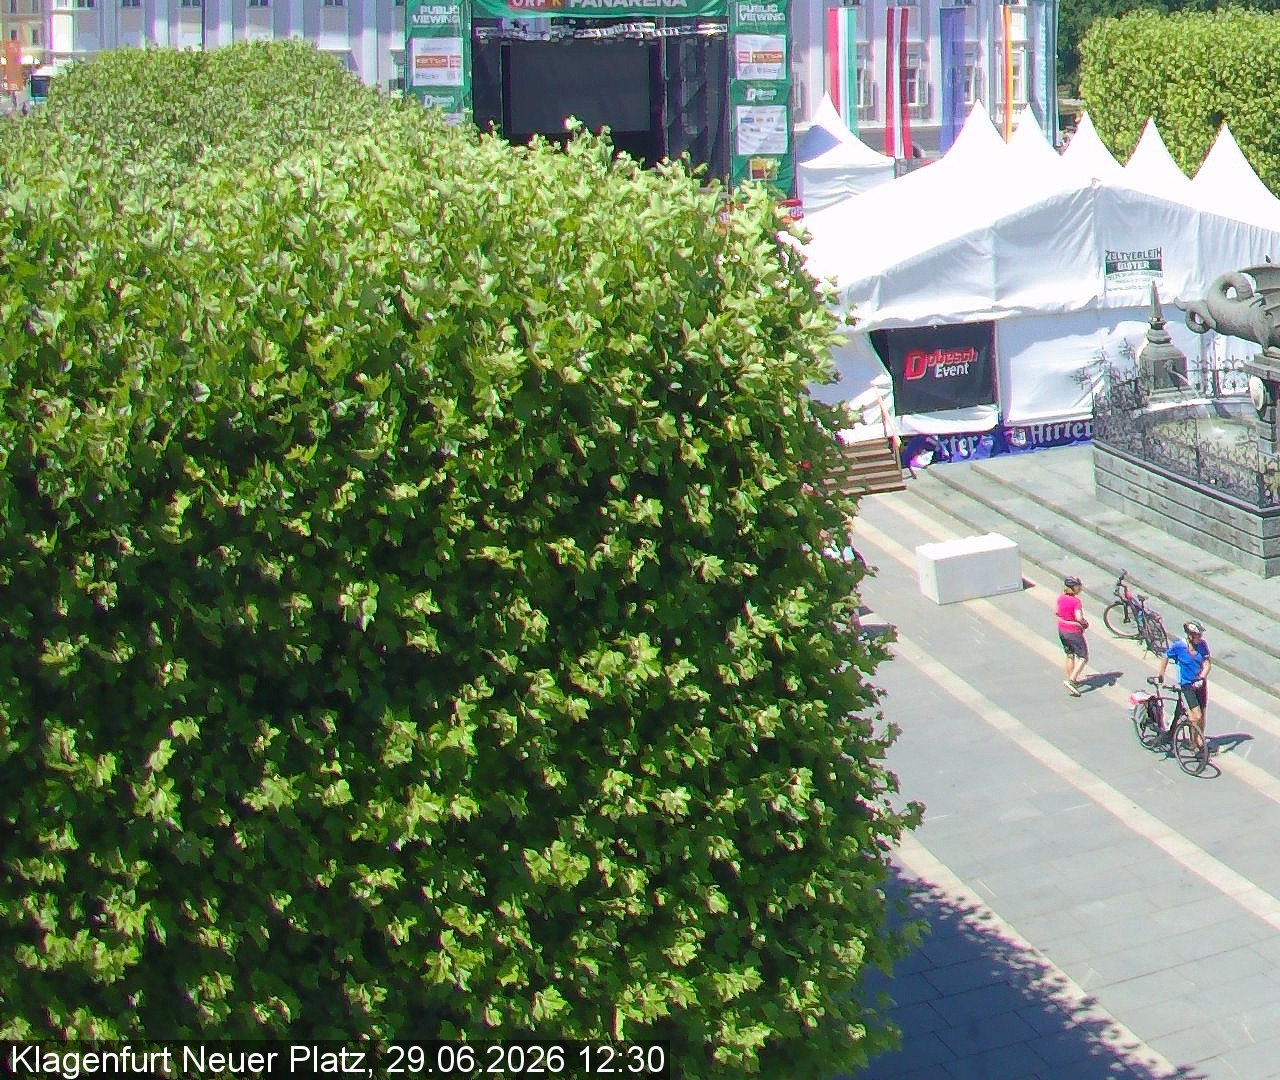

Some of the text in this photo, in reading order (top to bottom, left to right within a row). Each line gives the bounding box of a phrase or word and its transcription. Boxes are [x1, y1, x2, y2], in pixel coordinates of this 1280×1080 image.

[420, 4, 460, 15] PUBLIC
[739, 3, 778, 13] PUBLIC
[412, 14, 460, 24] VIEWING
[739, 12, 786, 21] VIEWING
[935, 362, 970, 379] Event
